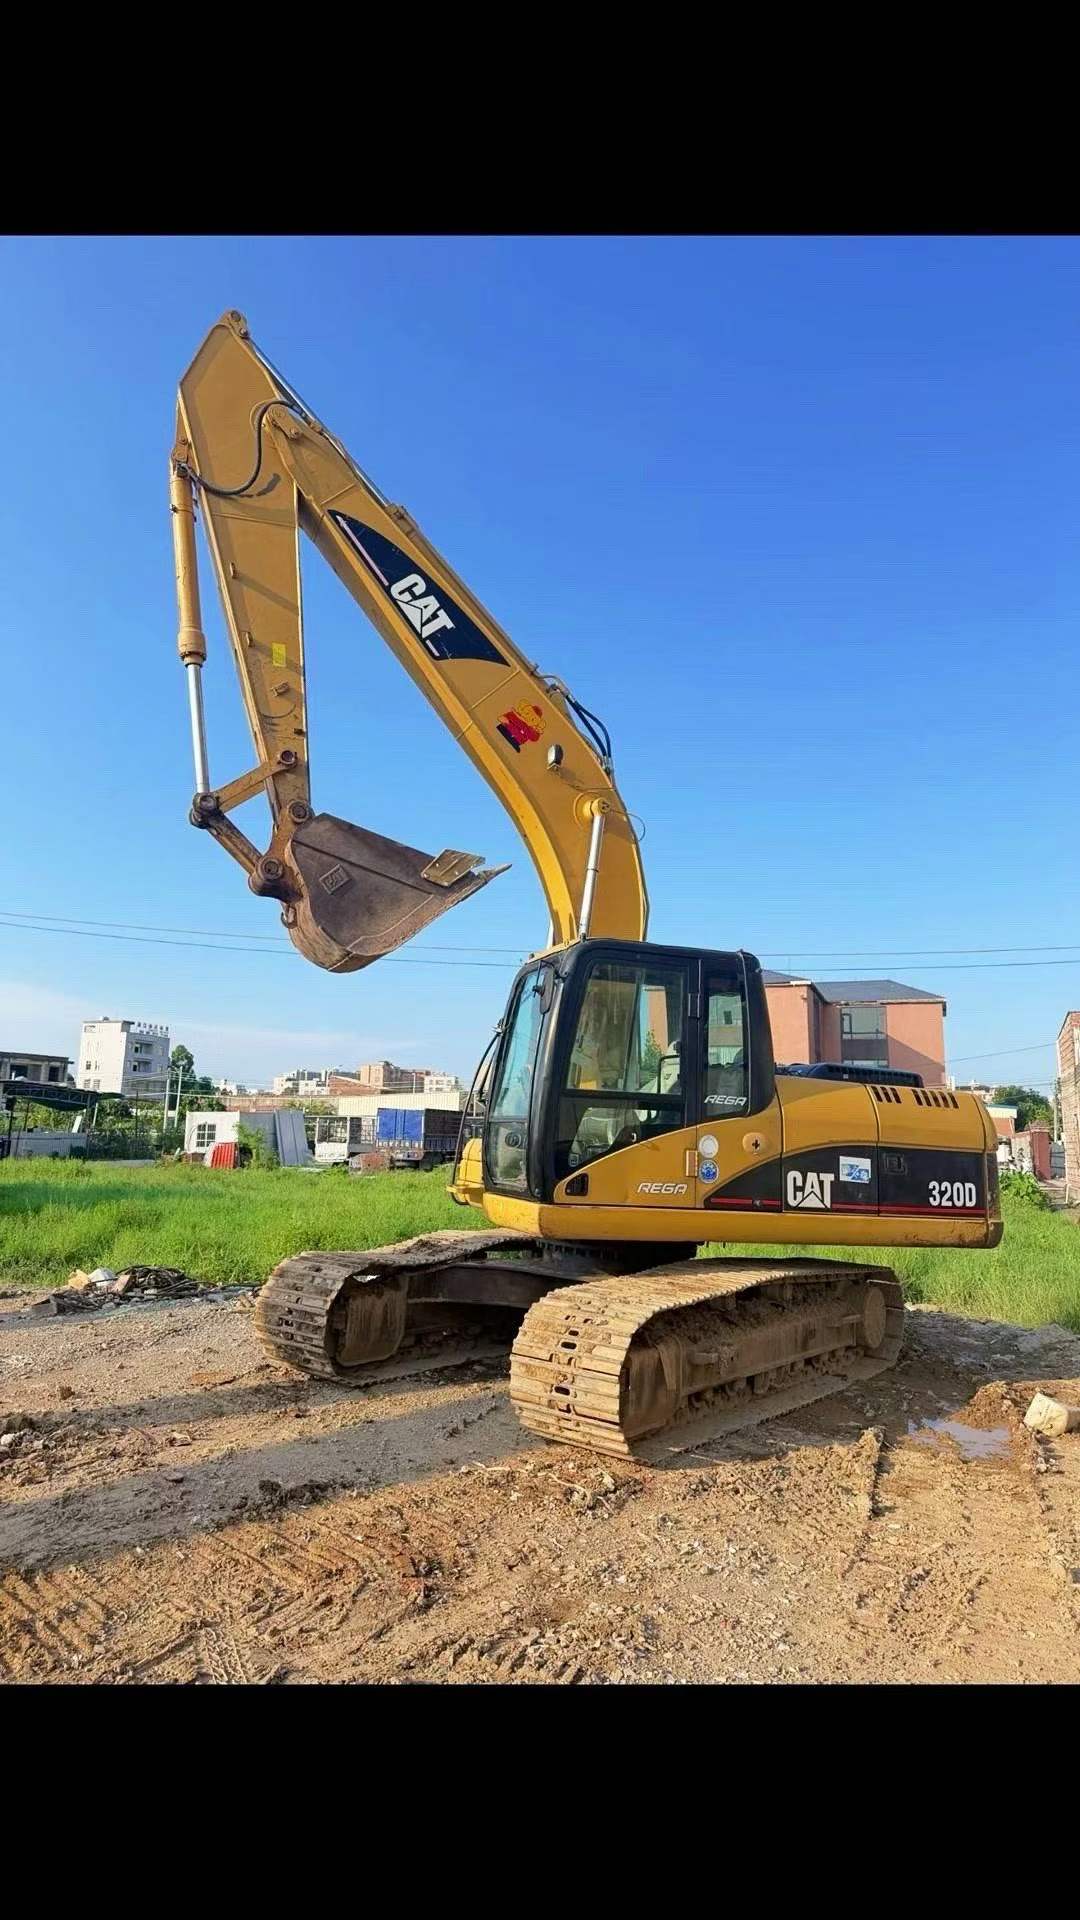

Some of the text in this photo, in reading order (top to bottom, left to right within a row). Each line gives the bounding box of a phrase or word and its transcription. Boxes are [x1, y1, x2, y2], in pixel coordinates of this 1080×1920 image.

[390, 573, 456, 639] CAT
[704, 1094, 747, 1106] REGA
[637, 1182, 688, 1195] REGA
[786, 1170, 835, 1208] CAT
[928, 1180, 977, 1207] 320D
